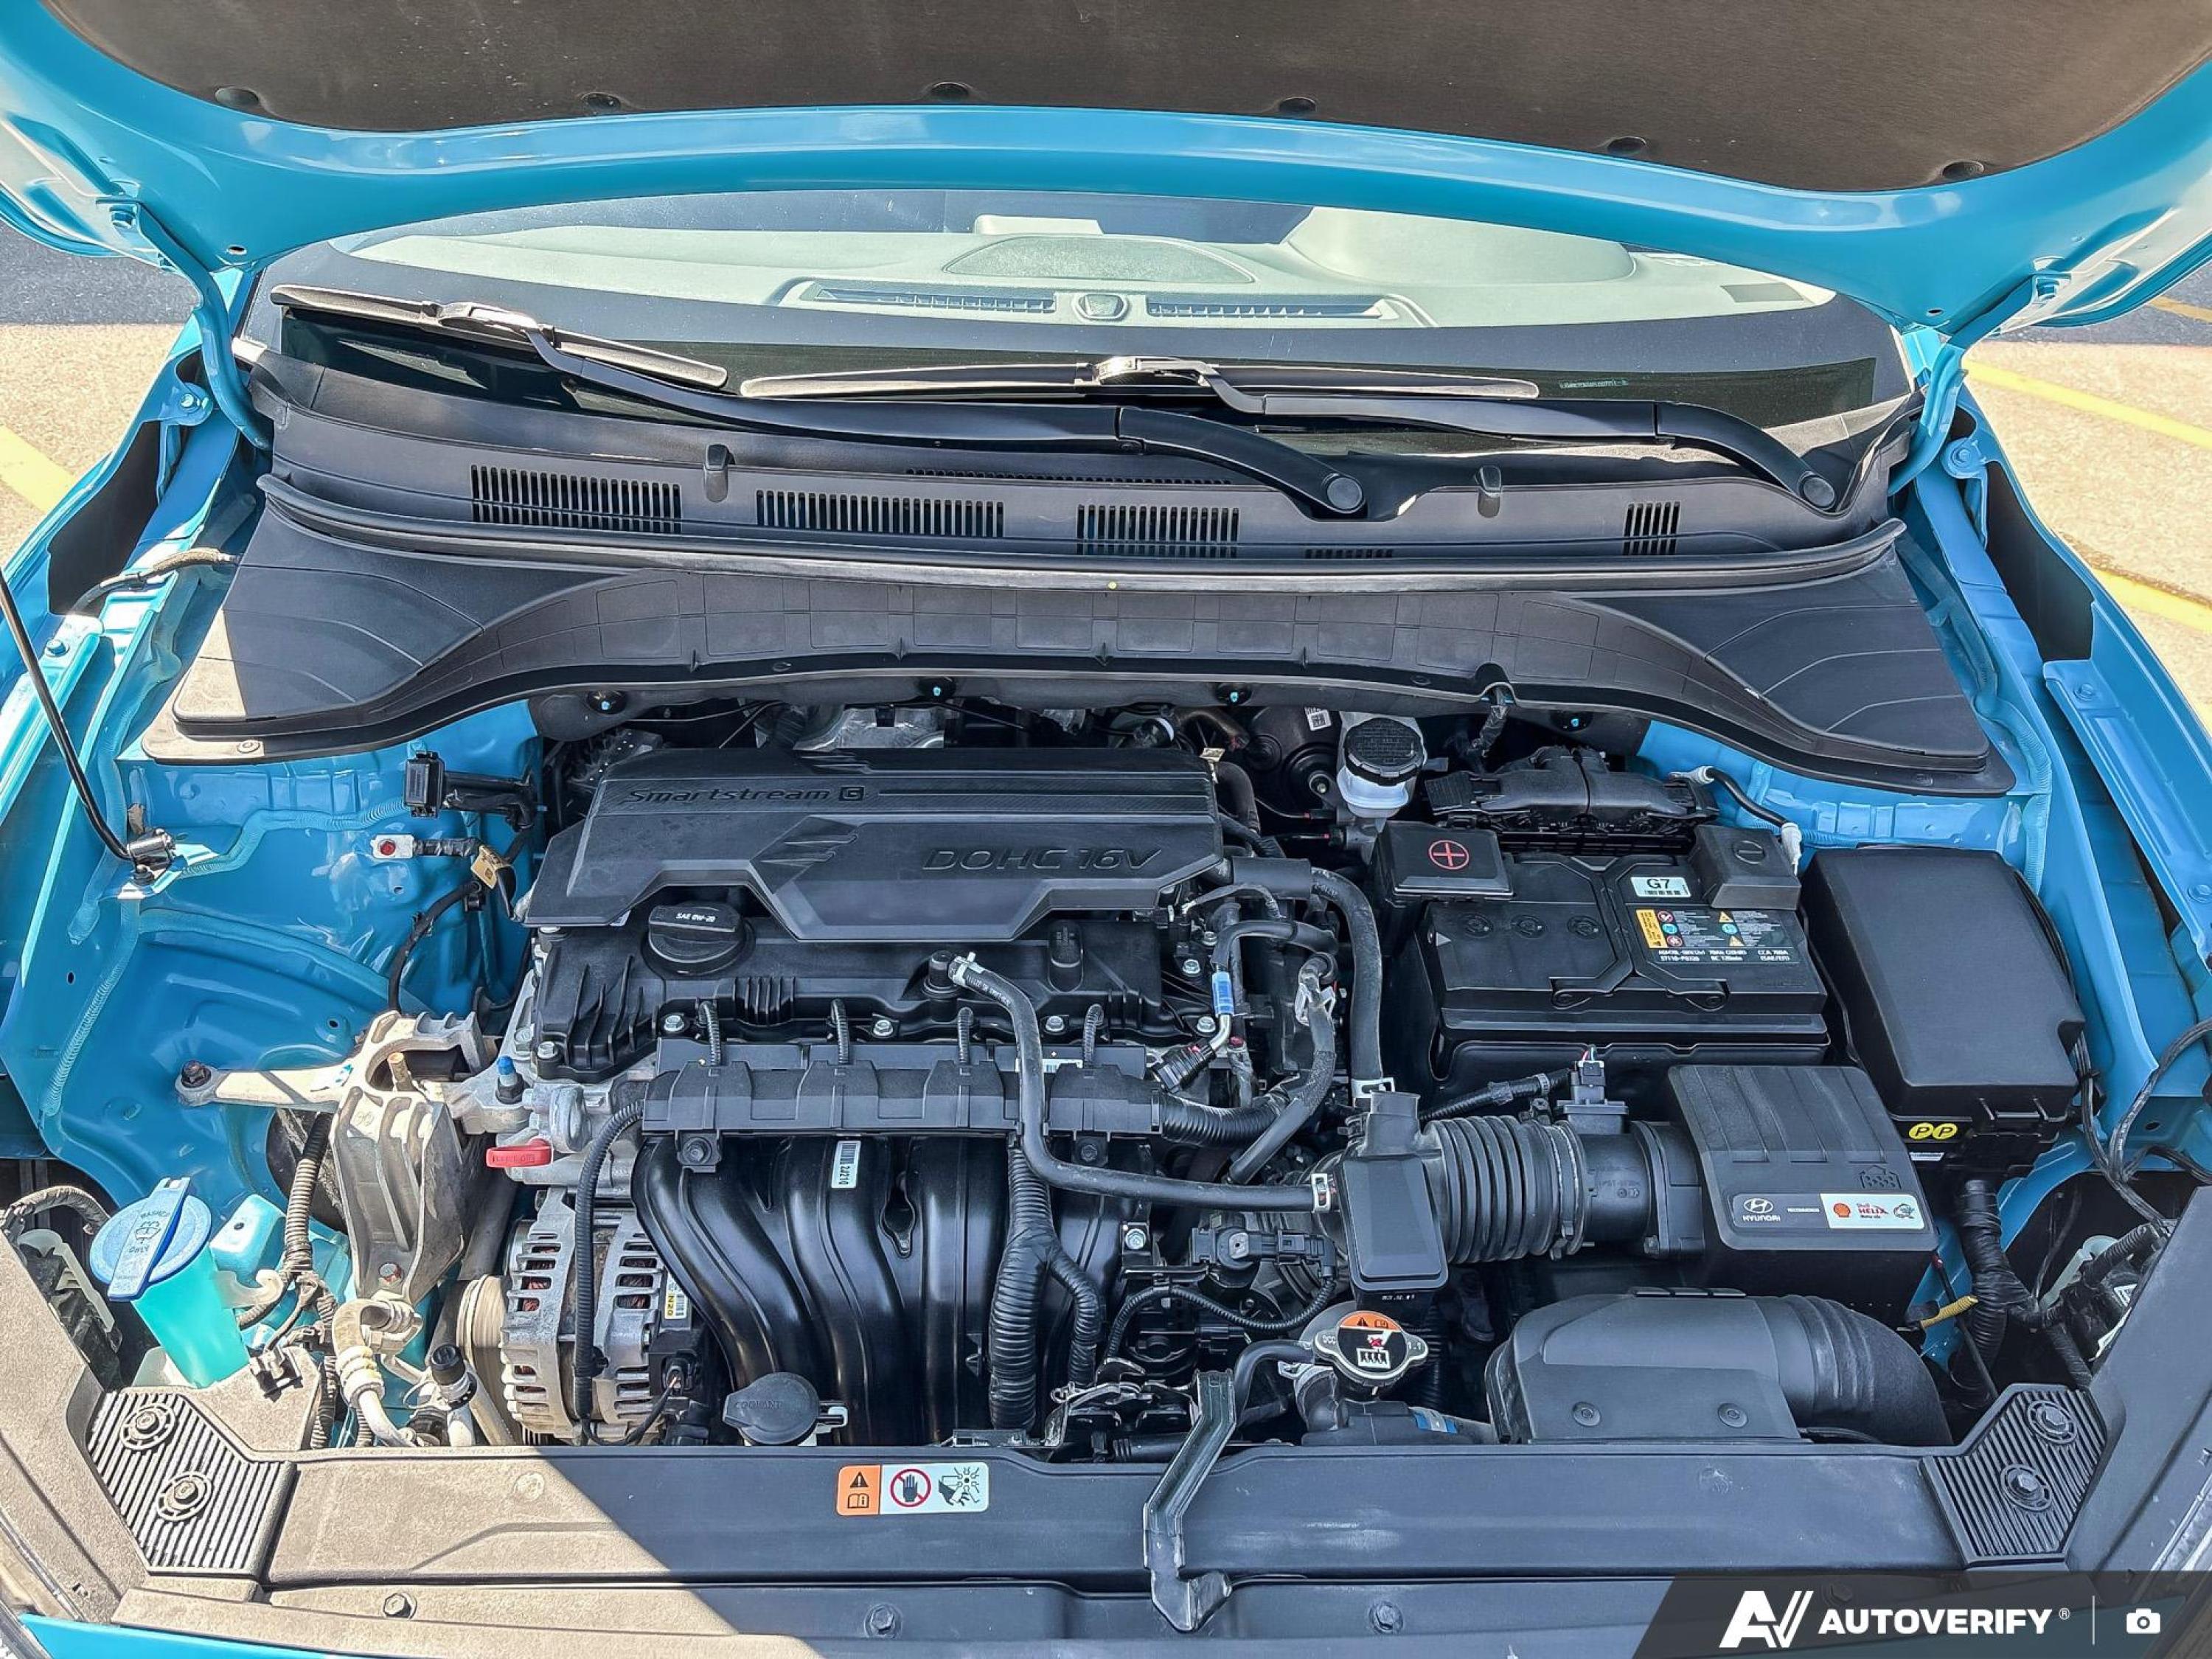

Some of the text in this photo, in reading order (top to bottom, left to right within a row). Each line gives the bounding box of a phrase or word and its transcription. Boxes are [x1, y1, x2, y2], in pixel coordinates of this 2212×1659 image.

[619, 788, 830, 804] Smartstream
[922, 849, 1163, 870] DOHC 16V
[1646, 878, 1670, 889] G7
[1915, 1126, 1930, 1137] P
[1938, 1126, 1954, 1138] P
[1742, 1214, 1781, 1222] HYUNDAI
[667, 1295, 675, 1316] N20
